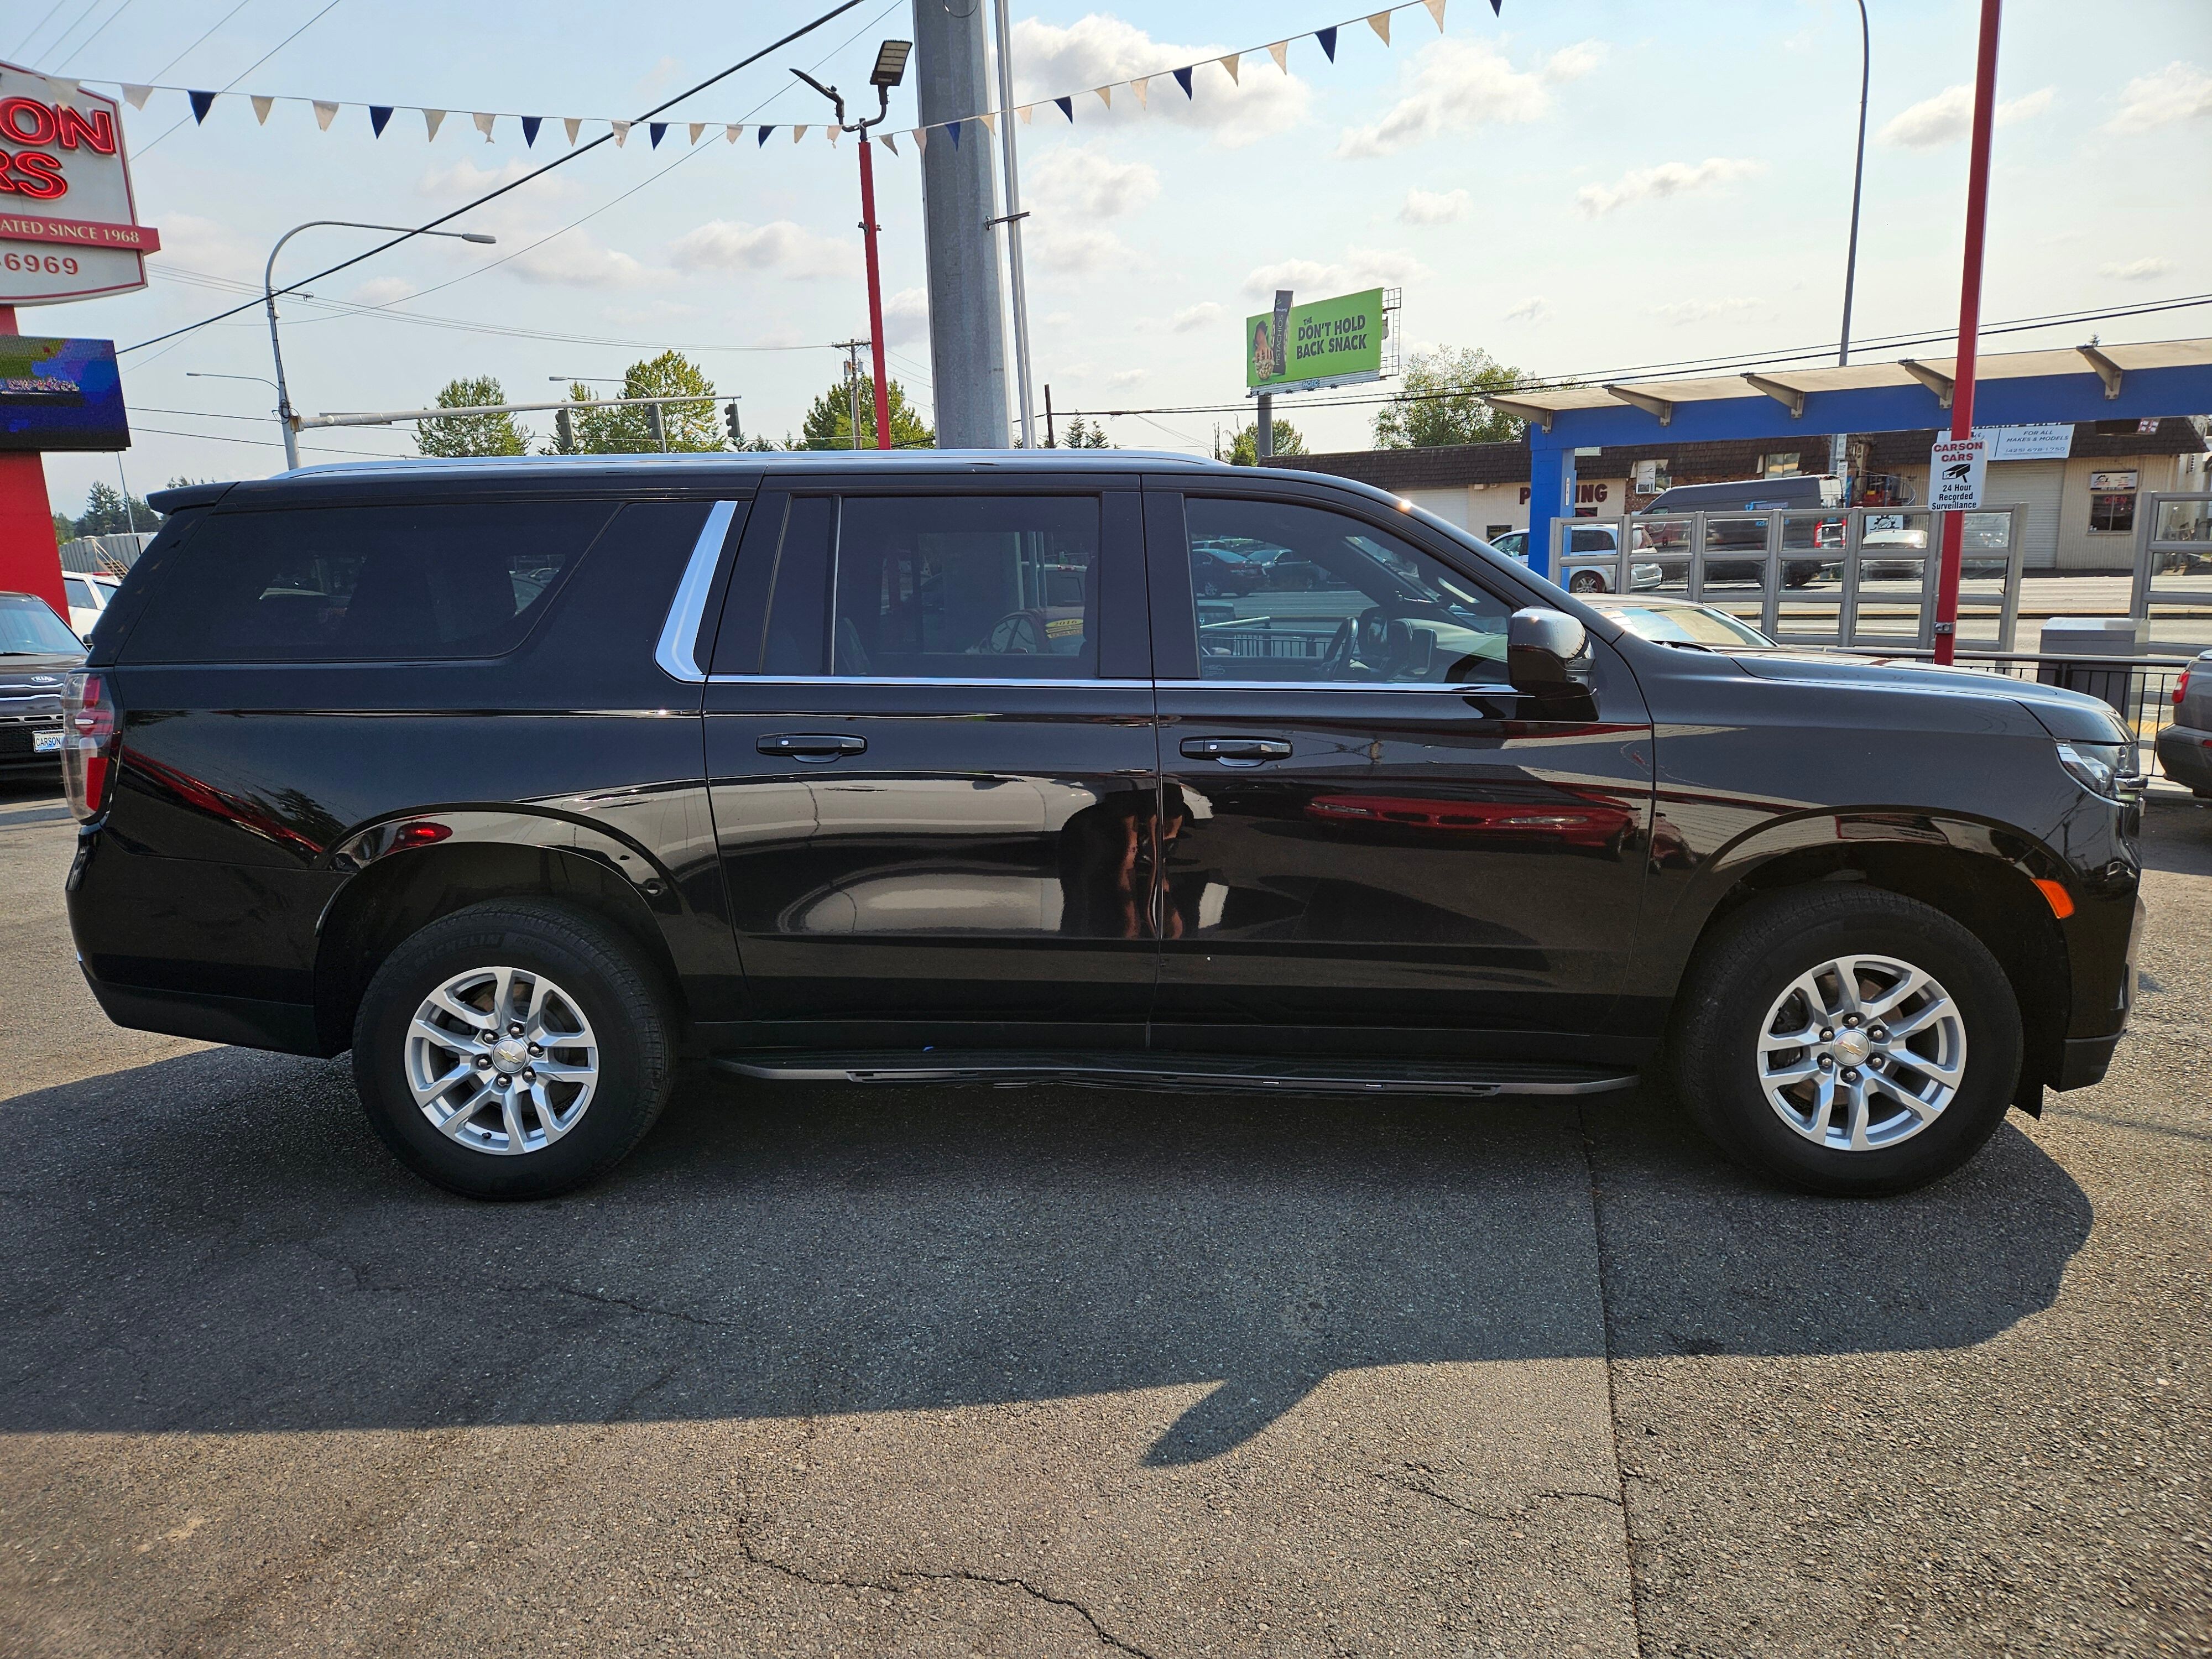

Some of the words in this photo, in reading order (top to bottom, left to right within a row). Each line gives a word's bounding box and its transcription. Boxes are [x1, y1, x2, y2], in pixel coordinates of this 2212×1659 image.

[1, 219, 44, 234] ATED
[49, 223, 97, 239] SINCE
[103, 228, 139, 243] 1968
[1303, 316, 1312, 325] THE
[1298, 322, 1331, 341] DON'T
[1334, 315, 1366, 335] HOLD
[1275, 314, 1284, 366] PISTACHIOS
[1296, 339, 1324, 359] BACK
[1328, 333, 1367, 353] SNACK
[1934, 442, 1983, 452] CARSON
[1942, 453, 1973, 462] CARS
[1939, 492, 1973, 500] Recorded
[1932, 501, 1976, 510] Surveillance
[36, 737, 61, 747] CARSON
